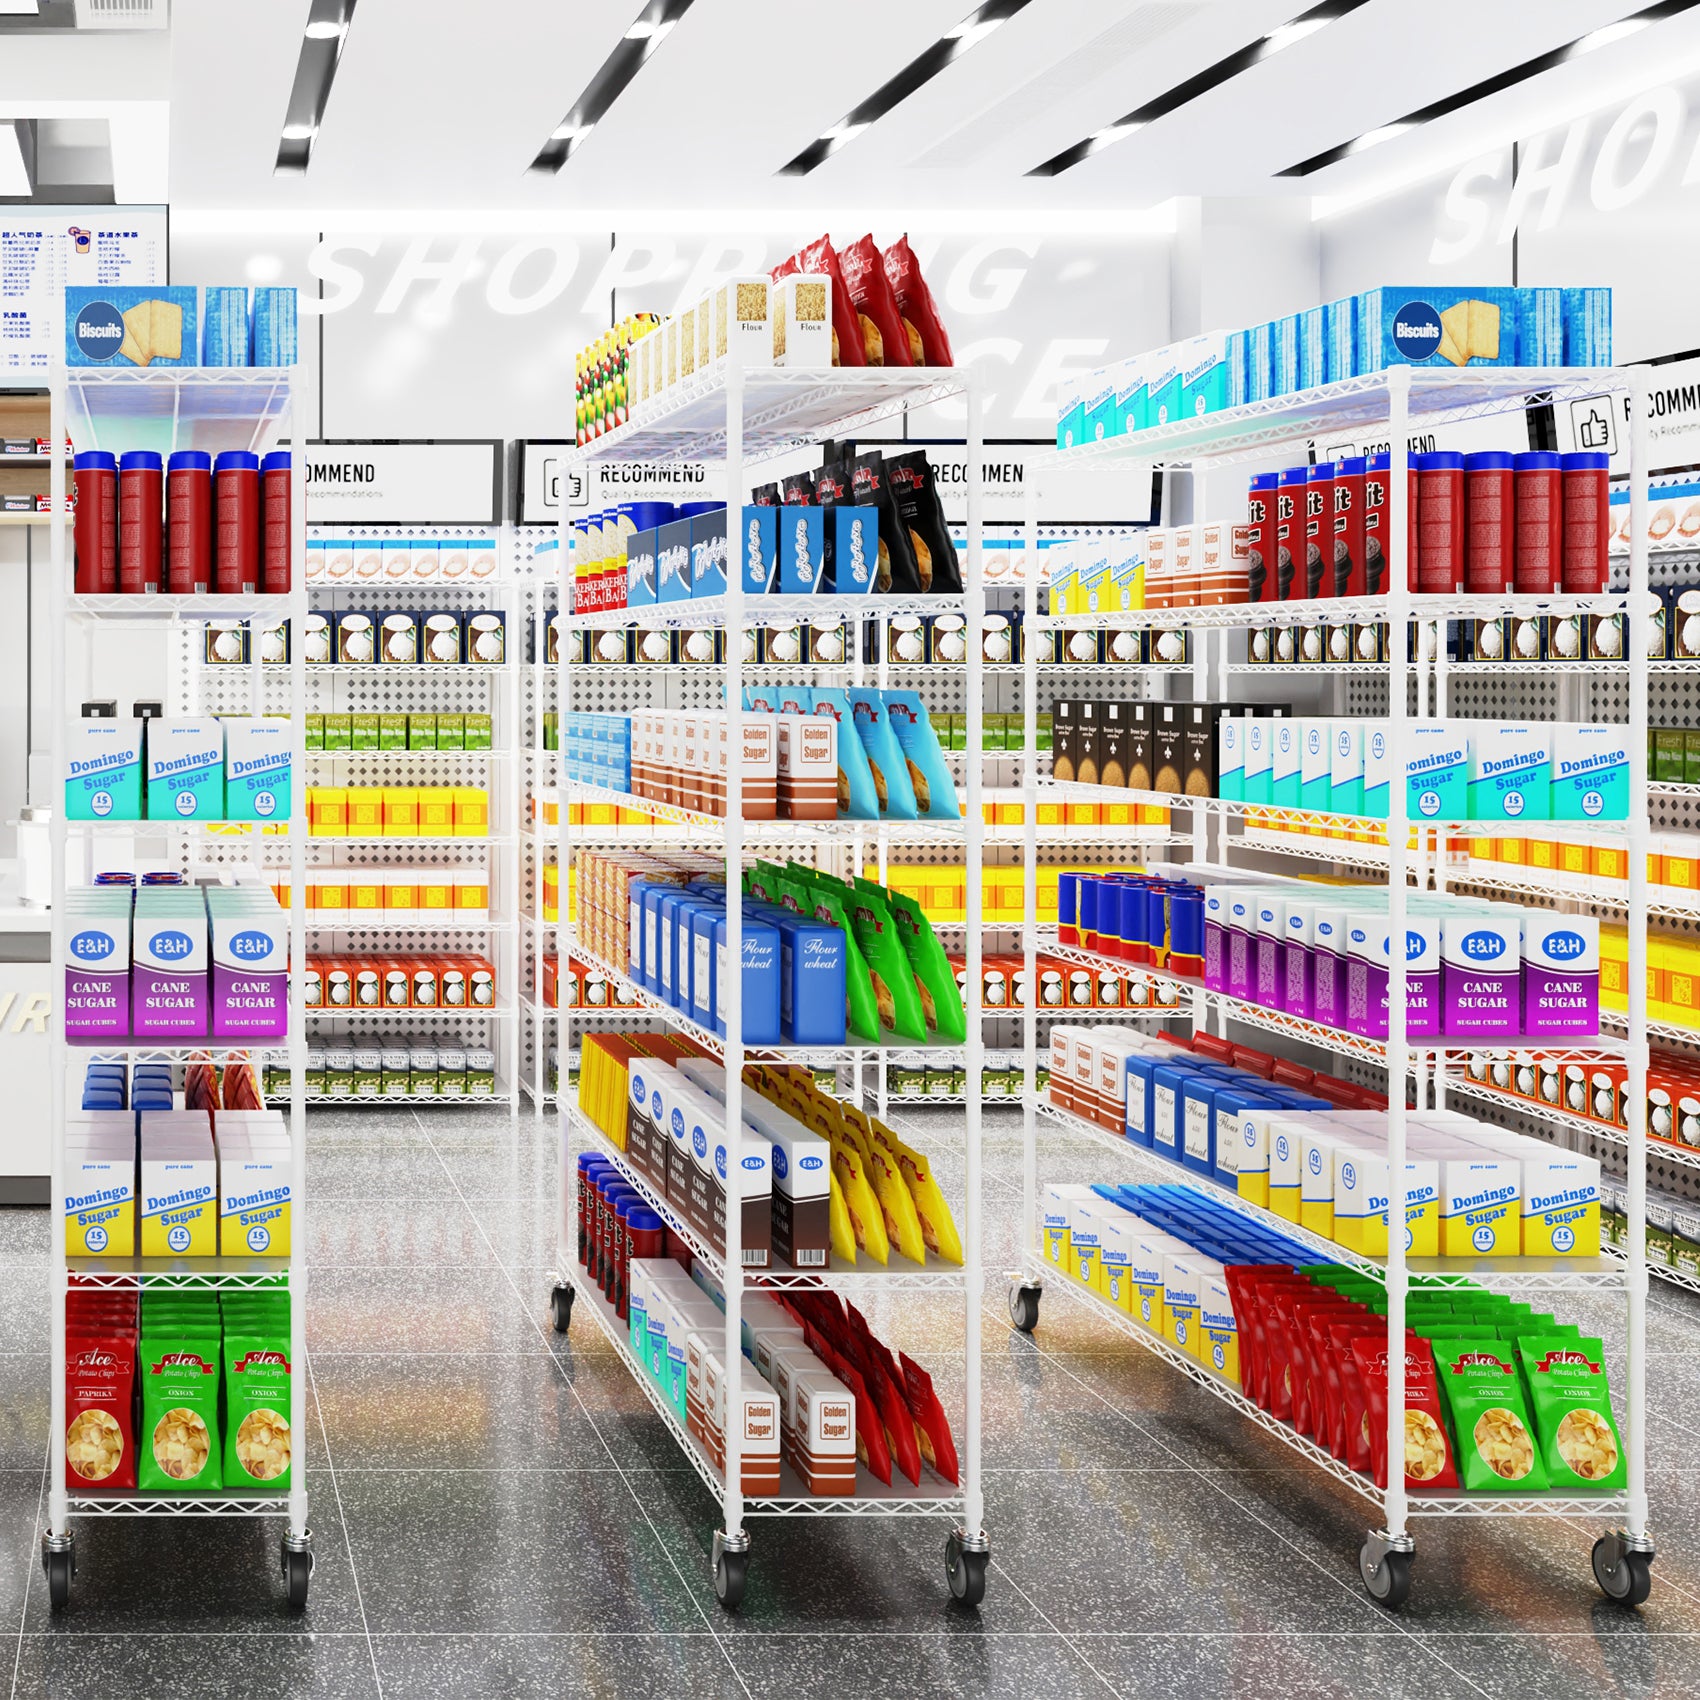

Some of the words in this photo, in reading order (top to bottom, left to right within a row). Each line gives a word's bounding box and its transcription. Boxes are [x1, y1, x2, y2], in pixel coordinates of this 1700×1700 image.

[1428, 85, 1700, 265] SHO
[296, 231, 1044, 315] SHOPPG
[79, 322, 122, 338] Biscuits
[1396, 322, 1439, 338] Biscuits
[1184, 354, 1217, 383] Domingo
[306, 464, 374, 483] OMMEND
[743, 729, 767, 740] Golden
[804, 729, 828, 740] Golden
[743, 747, 767, 759] Sugar
[804, 747, 828, 759] Sugar
[70, 750, 134, 774] Domingo
[154, 750, 218, 774] Domingo
[1482, 750, 1545, 774] Domingo
[1560, 750, 1625, 774] Domingo
[83, 772, 125, 790] Sugar
[167, 772, 209, 790] Sugar
[246, 772, 288, 790] Sugar
[1410, 772, 1454, 790] Sugar
[1495, 772, 1537, 790] Sugar
[1574, 772, 1617, 790] Sugar
[96, 796, 108, 804] 15
[180, 796, 192, 804] 15
[260, 796, 271, 804] 15
[1424, 796, 1435, 804] 15
[1508, 796, 1519, 804] 15
[1587, 796, 1598, 804] 15
[77, 938, 109, 953] E&H
[155, 938, 188, 953] E&H
[236, 938, 268, 953] E&H
[741, 938, 773, 955] Flour
[804, 938, 838, 955] Flour
[1468, 938, 1500, 953] E&H
[1548, 938, 1580, 953] E&H
[804, 956, 838, 969] wheat
[72, 982, 111, 993] CANE
[151, 982, 190, 993] CANE
[231, 982, 270, 993] CANE
[1463, 982, 1502, 993] CANE
[1544, 982, 1582, 993] CANE
[67, 998, 117, 1008] SUGAR
[145, 998, 195, 1008] SUGAR
[226, 998, 276, 1008] SUGAR
[1381, 998, 1428, 1008] SGAR
[1458, 998, 1508, 1008] SUGAR
[1539, 998, 1588, 1008] SUGAR
[65, 1186, 128, 1210] Domingo
[147, 1186, 211, 1210] Domingo
[226, 1186, 290, 1210] Domingo
[1368, 1186, 1434, 1210] Dongo
[1452, 1186, 1516, 1210] Domingo
[1530, 1186, 1595, 1210] Domingo
[77, 1208, 120, 1226] Sugar
[160, 1208, 203, 1226] Sugar
[239, 1208, 282, 1226] Sugar
[1465, 1207, 1507, 1226] Sugar
[1544, 1207, 1587, 1226] Sugar
[91, 1231, 102, 1240] 15
[174, 1231, 185, 1240] 15
[253, 1231, 264, 1240] 15
[1072, 1231, 1098, 1244] Domingo
[1478, 1231, 1489, 1240] 15
[1558, 1231, 1569, 1240] 15
[1077, 1246, 1094, 1258] Sugar
[1102, 1249, 1127, 1262] Domingo
[1107, 1264, 1124, 1277] Sugar
[1133, 1267, 1159, 1281] Domingo
[1139, 1284, 1156, 1297] Sugar
[1166, 1288, 1197, 1303] Domingo
[1172, 1306, 1193, 1320] Sugar
[1202, 1311, 1236, 1327] Domingo
[1209, 1330, 1231, 1345] Sugar
[78, 1347, 113, 1366] Ace
[164, 1349, 199, 1367] Ace
[247, 1347, 281, 1365] Ace
[1463, 1349, 1496, 1366] Ace
[1550, 1347, 1583, 1366] Ace
[748, 1406, 771, 1417] Golden
[824, 1406, 847, 1417] Golden
[748, 1423, 771, 1437] Sugar
[824, 1423, 847, 1437] Sugar
